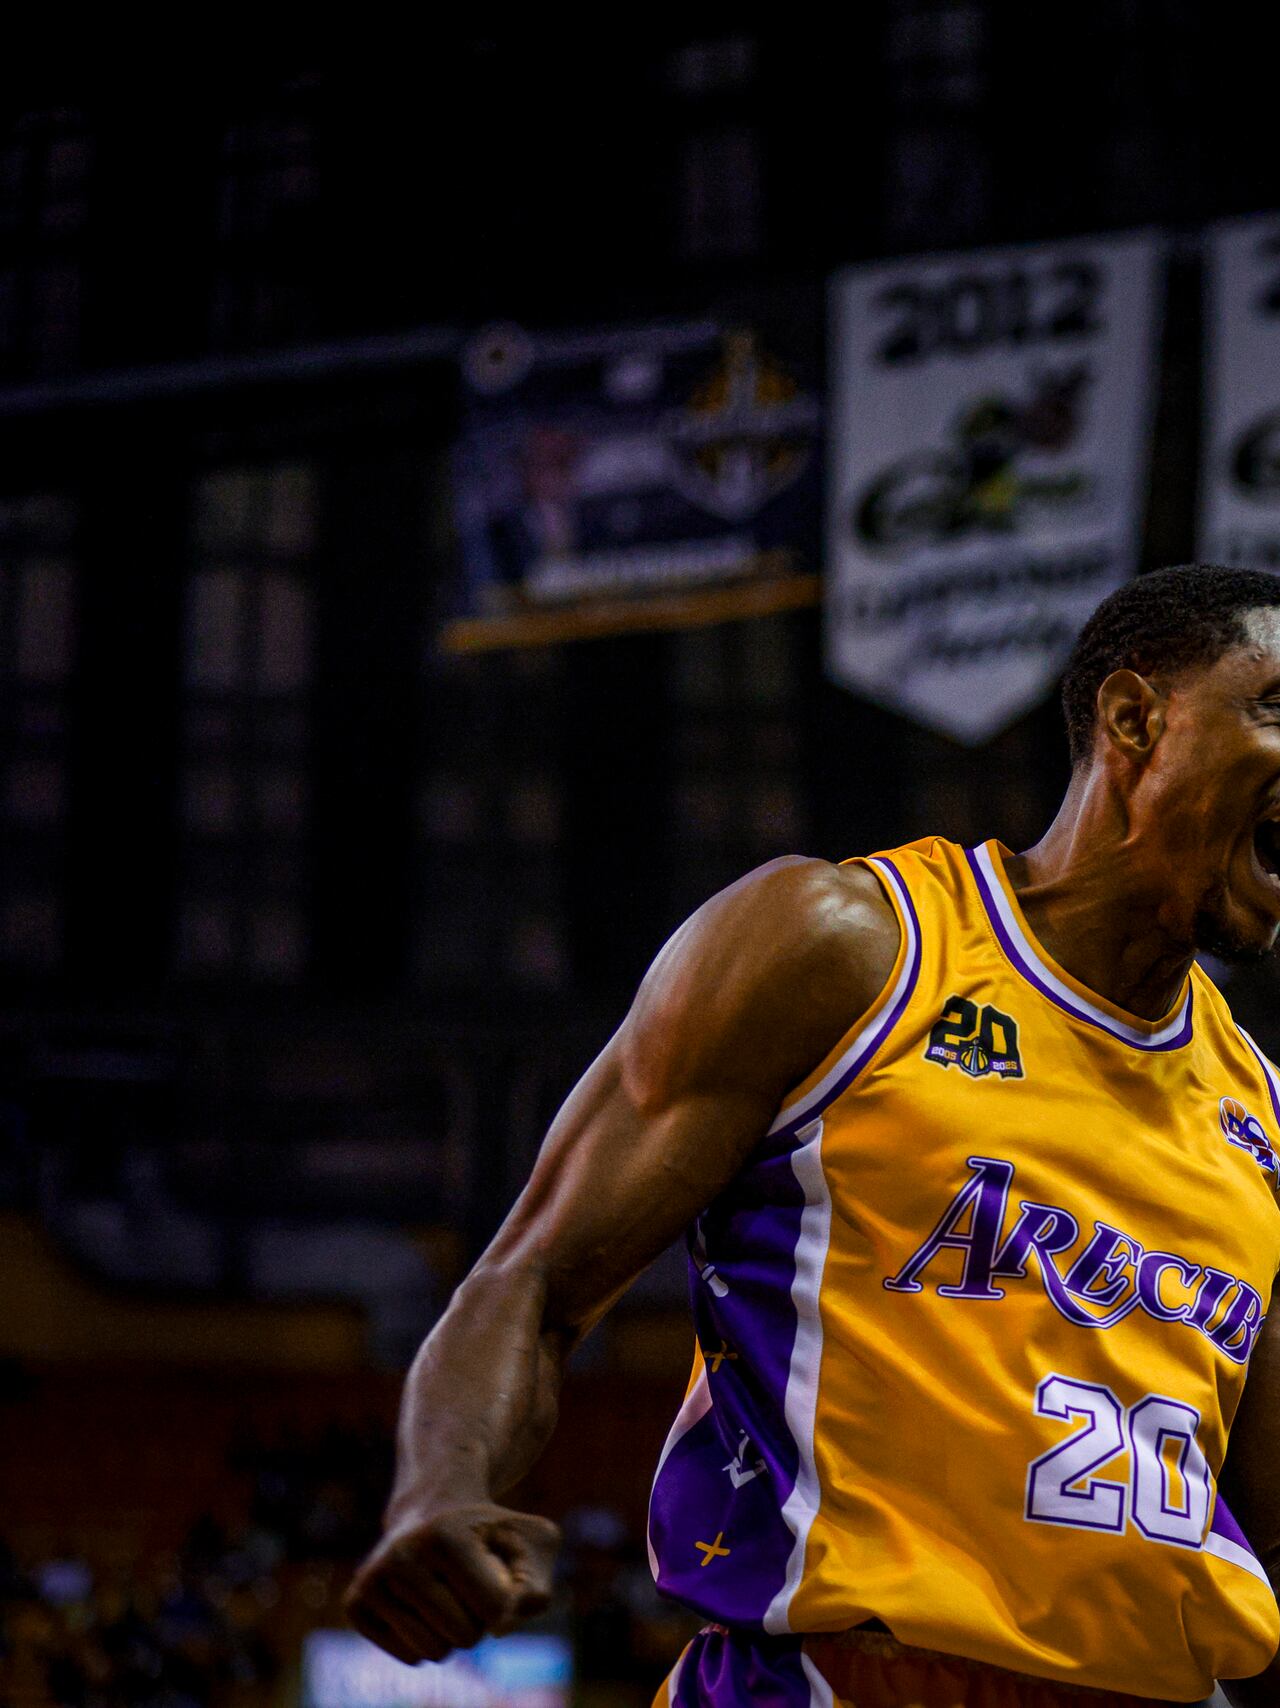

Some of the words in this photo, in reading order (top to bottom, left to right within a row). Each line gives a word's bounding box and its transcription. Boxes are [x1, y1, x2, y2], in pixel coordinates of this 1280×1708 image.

[873, 258, 1106, 366] 2012
[929, 995, 1019, 1060] 20
[931, 1046, 957, 1060] 2005
[883, 1155, 1266, 1364] ARECIB
[1024, 1371, 1215, 1552] 20
